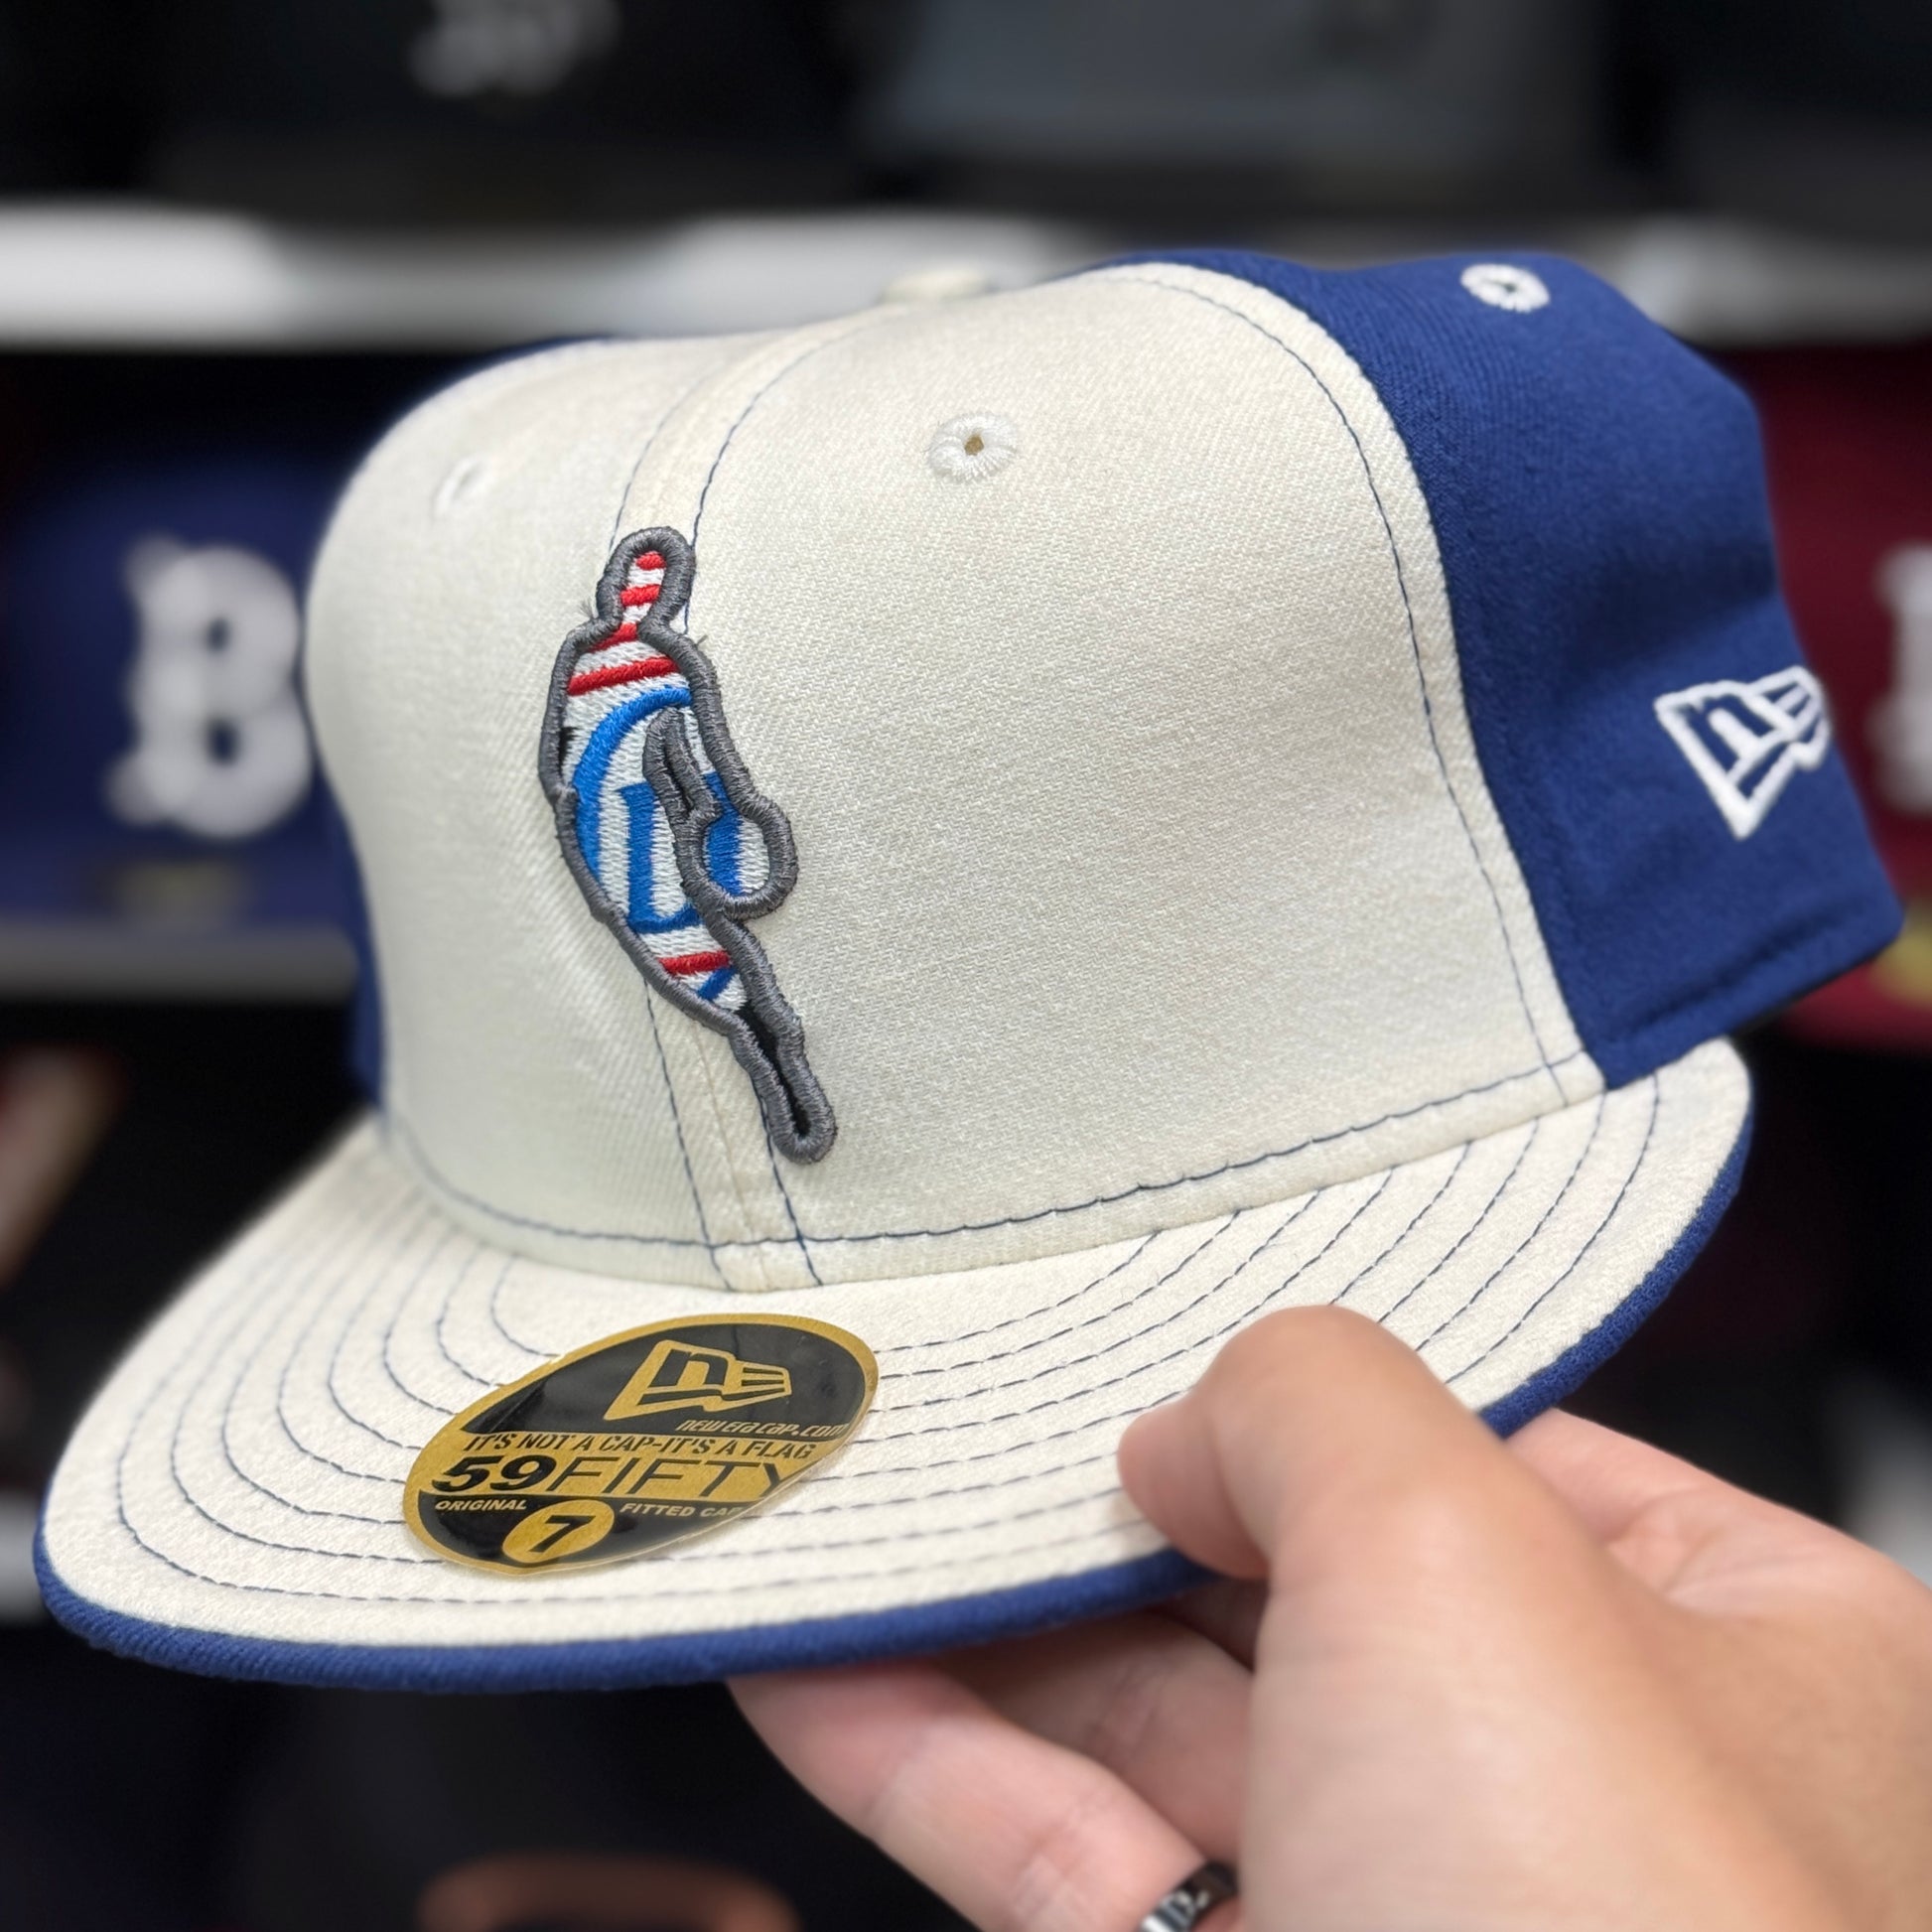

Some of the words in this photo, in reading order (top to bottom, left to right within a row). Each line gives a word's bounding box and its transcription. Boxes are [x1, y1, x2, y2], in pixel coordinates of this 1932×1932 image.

[463, 1433, 516, 1451] IT'S
[516, 1433, 574, 1450] NOT
[573, 1435, 598, 1451] A
[714, 1439, 738, 1456] A
[741, 1440, 817, 1459] FLAG
[431, 1454, 781, 1499] 59FIFTY
[434, 1499, 527, 1511] ORIGINAL
[620, 1502, 696, 1517] FITTED
[528, 1515, 597, 1553] 7
